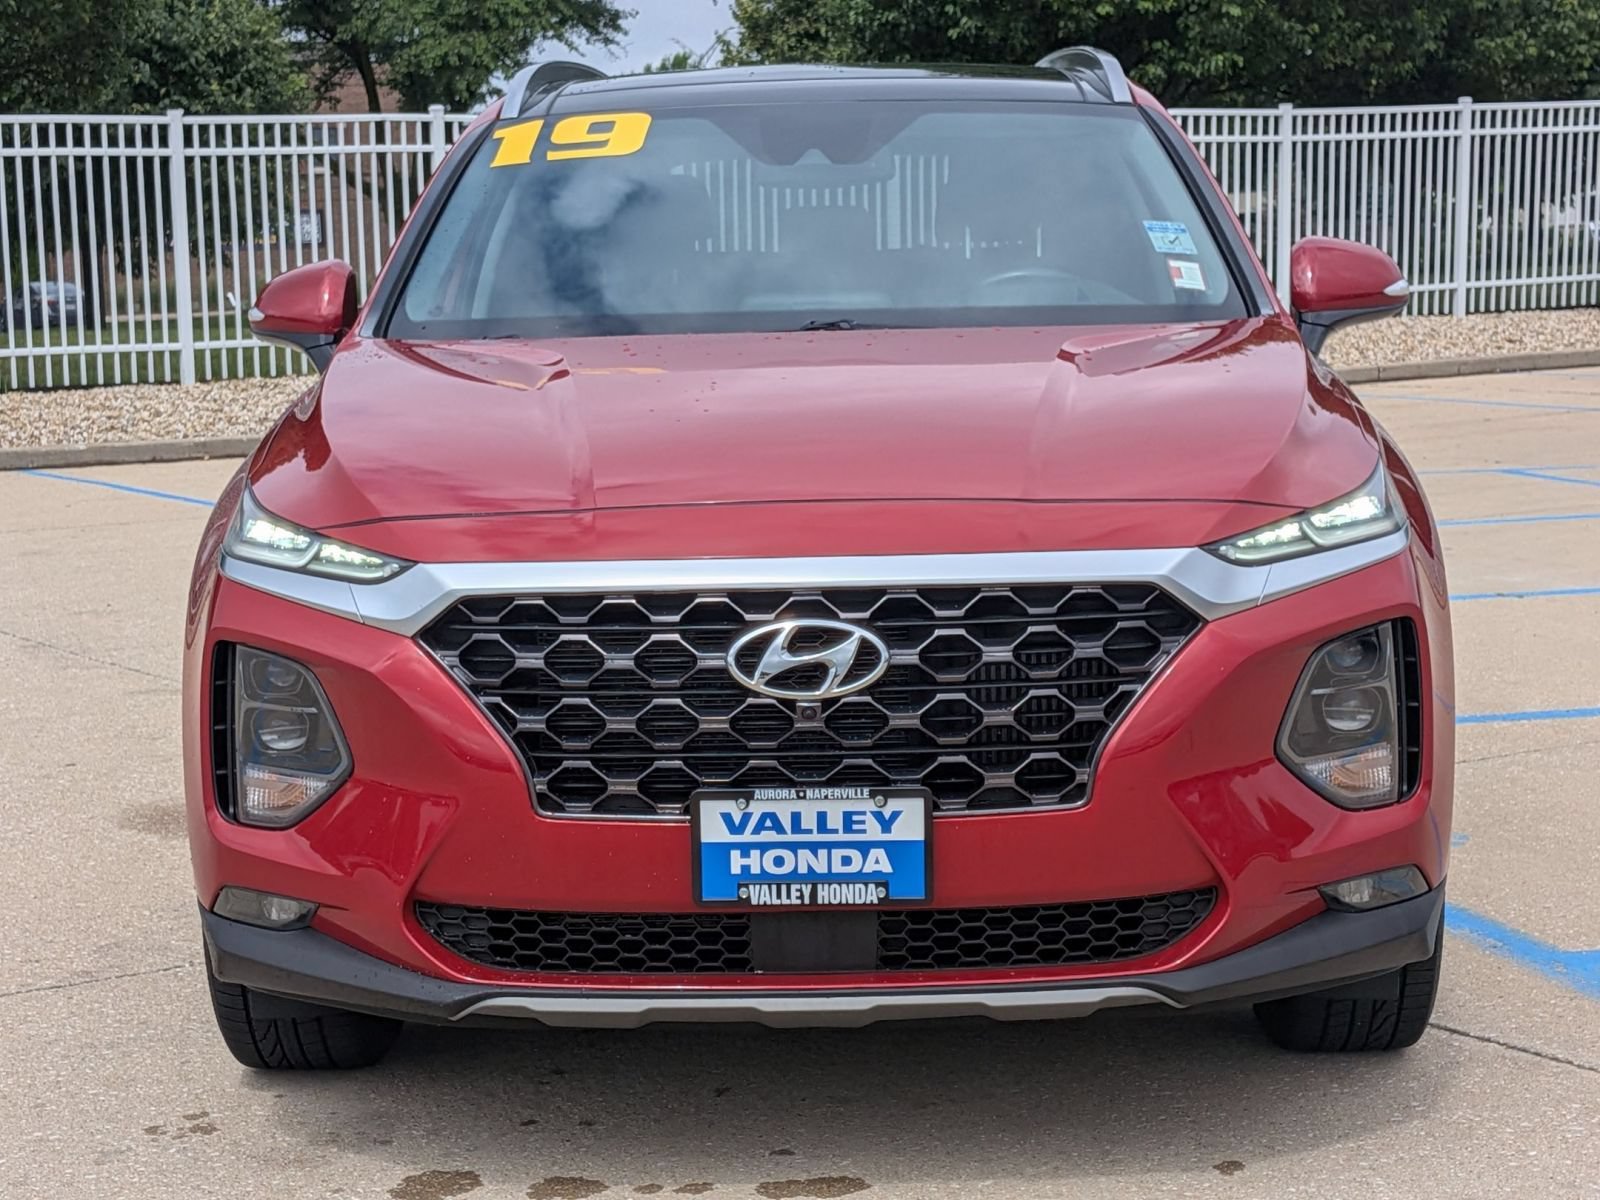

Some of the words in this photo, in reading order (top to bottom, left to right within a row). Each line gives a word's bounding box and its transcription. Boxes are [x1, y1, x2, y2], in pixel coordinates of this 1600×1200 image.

[489, 112, 652, 168] 19
[754, 789, 797, 800] AURORA
[806, 788, 870, 800] NAPERVILLE
[719, 810, 904, 835] VALLEY
[730, 848, 893, 875] HONDA
[748, 884, 812, 905] VALLEY
[817, 883, 879, 904] HONDA
